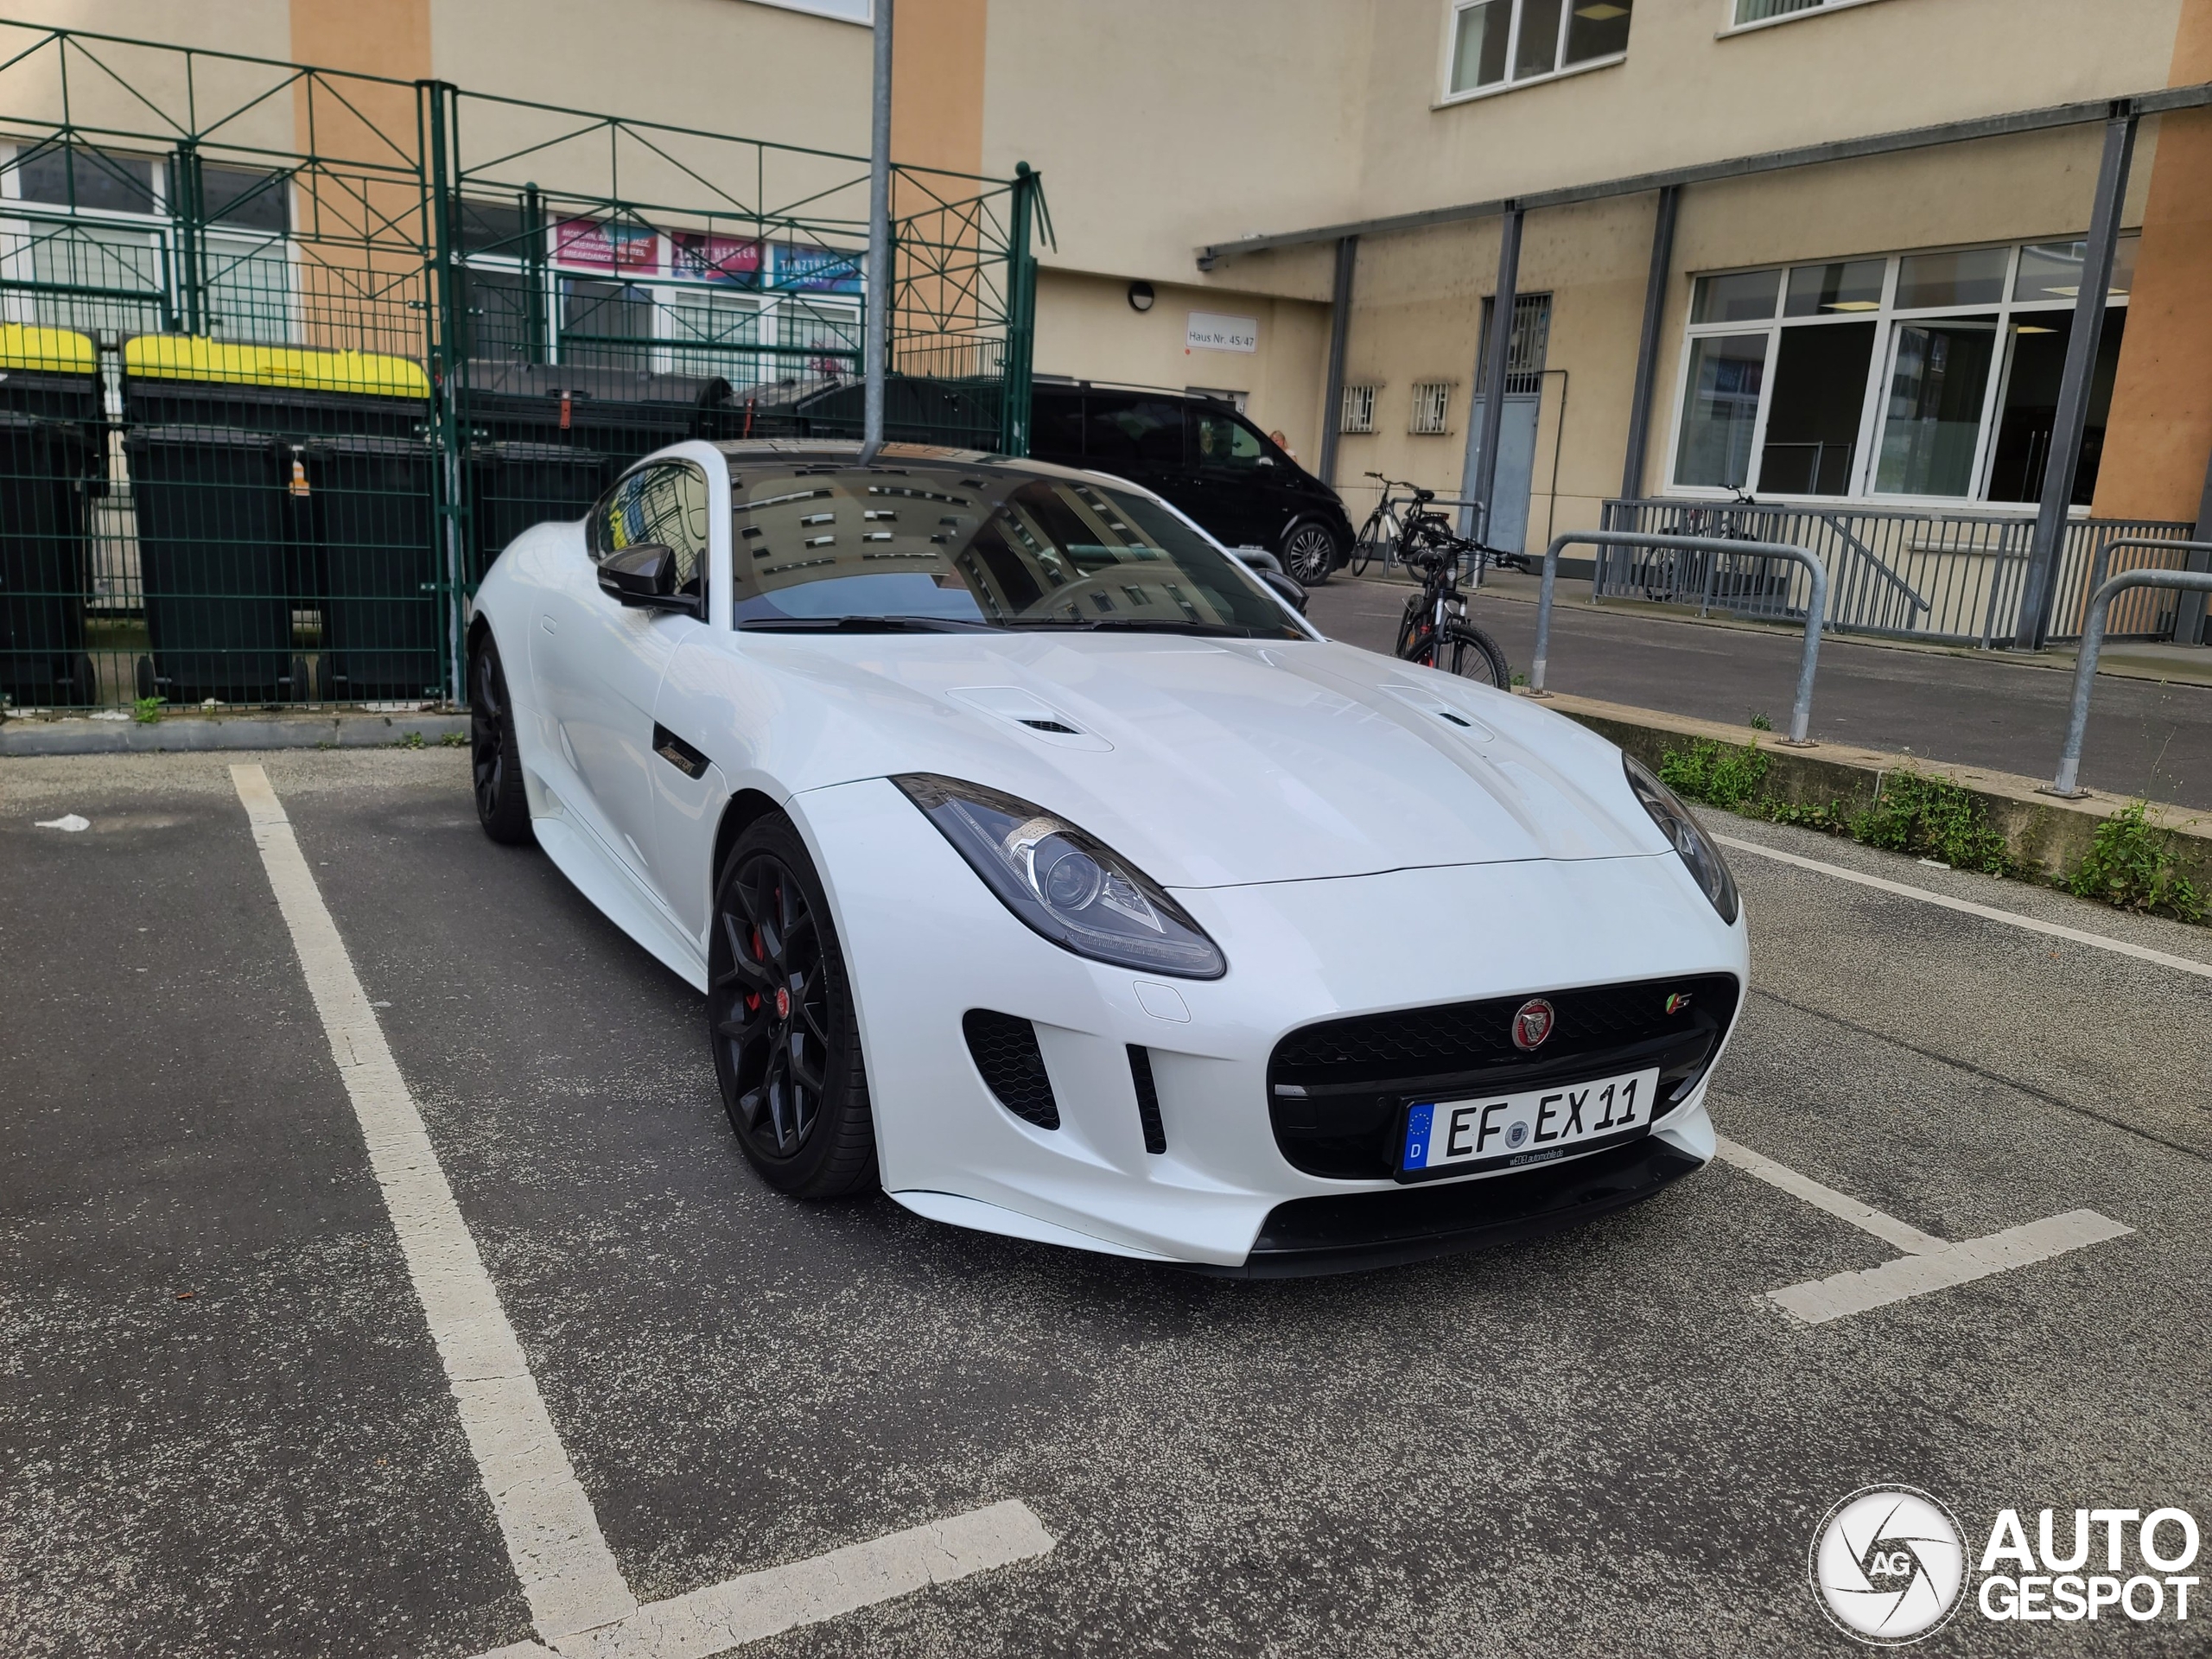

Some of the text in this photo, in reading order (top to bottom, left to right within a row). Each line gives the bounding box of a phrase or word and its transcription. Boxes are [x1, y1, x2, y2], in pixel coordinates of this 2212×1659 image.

[616, 247, 645, 257] PILTES,
[677, 247, 757, 259] TANZHEATER
[1189, 331, 1254, 346] Haus Nr. 45/47
[1446, 1103, 1509, 1157] EF
[1410, 1144, 1421, 1158] D
